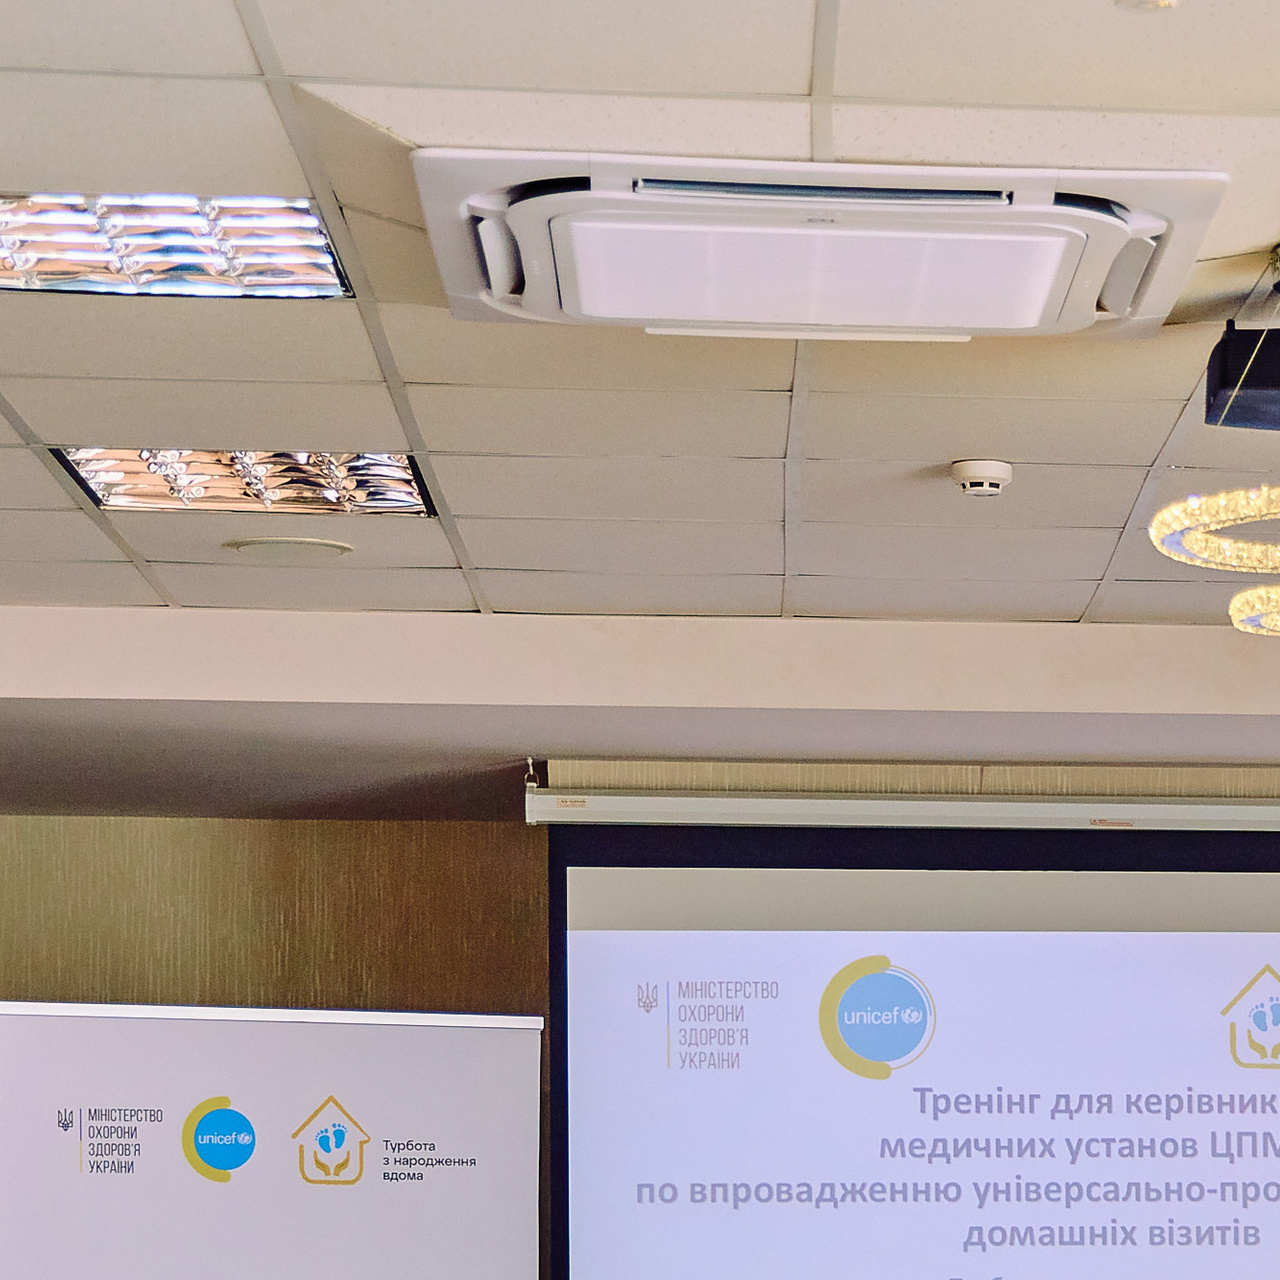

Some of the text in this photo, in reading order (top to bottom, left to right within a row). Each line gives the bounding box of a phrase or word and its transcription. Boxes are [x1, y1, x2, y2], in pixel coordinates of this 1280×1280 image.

[678, 980, 779, 1000] МІНІСТЕРСТВО
[678, 1004, 745, 1023] ОХОРОНИ
[844, 1006, 900, 1025] unicef
[678, 1028, 749, 1048] ЗДОРОВ'Я
[678, 1051, 741, 1070] УКРАЇНИ
[913, 1086, 1041, 1121] Тренінг
[1050, 1091, 1114, 1120] для
[87, 1107, 163, 1124] МІНІСТЕРСТВО
[87, 1124, 138, 1141] ОХОРОНИ
[198, 1131, 237, 1144] unicef
[87, 1141, 141, 1159] ЗДОРОВ'Я
[382, 1139, 436, 1155] Турбота
[880, 1137, 1056, 1165] медичних
[1065, 1137, 1199, 1166] установ
[87, 1158, 135, 1175] УКРАЇНИ
[382, 1155, 477, 1169] з народження
[382, 1170, 424, 1183] вдома
[637, 1182, 678, 1204] по
[690, 1181, 962, 1209] впровадженню
[962, 1218, 1261, 1253] домашніх візитів
